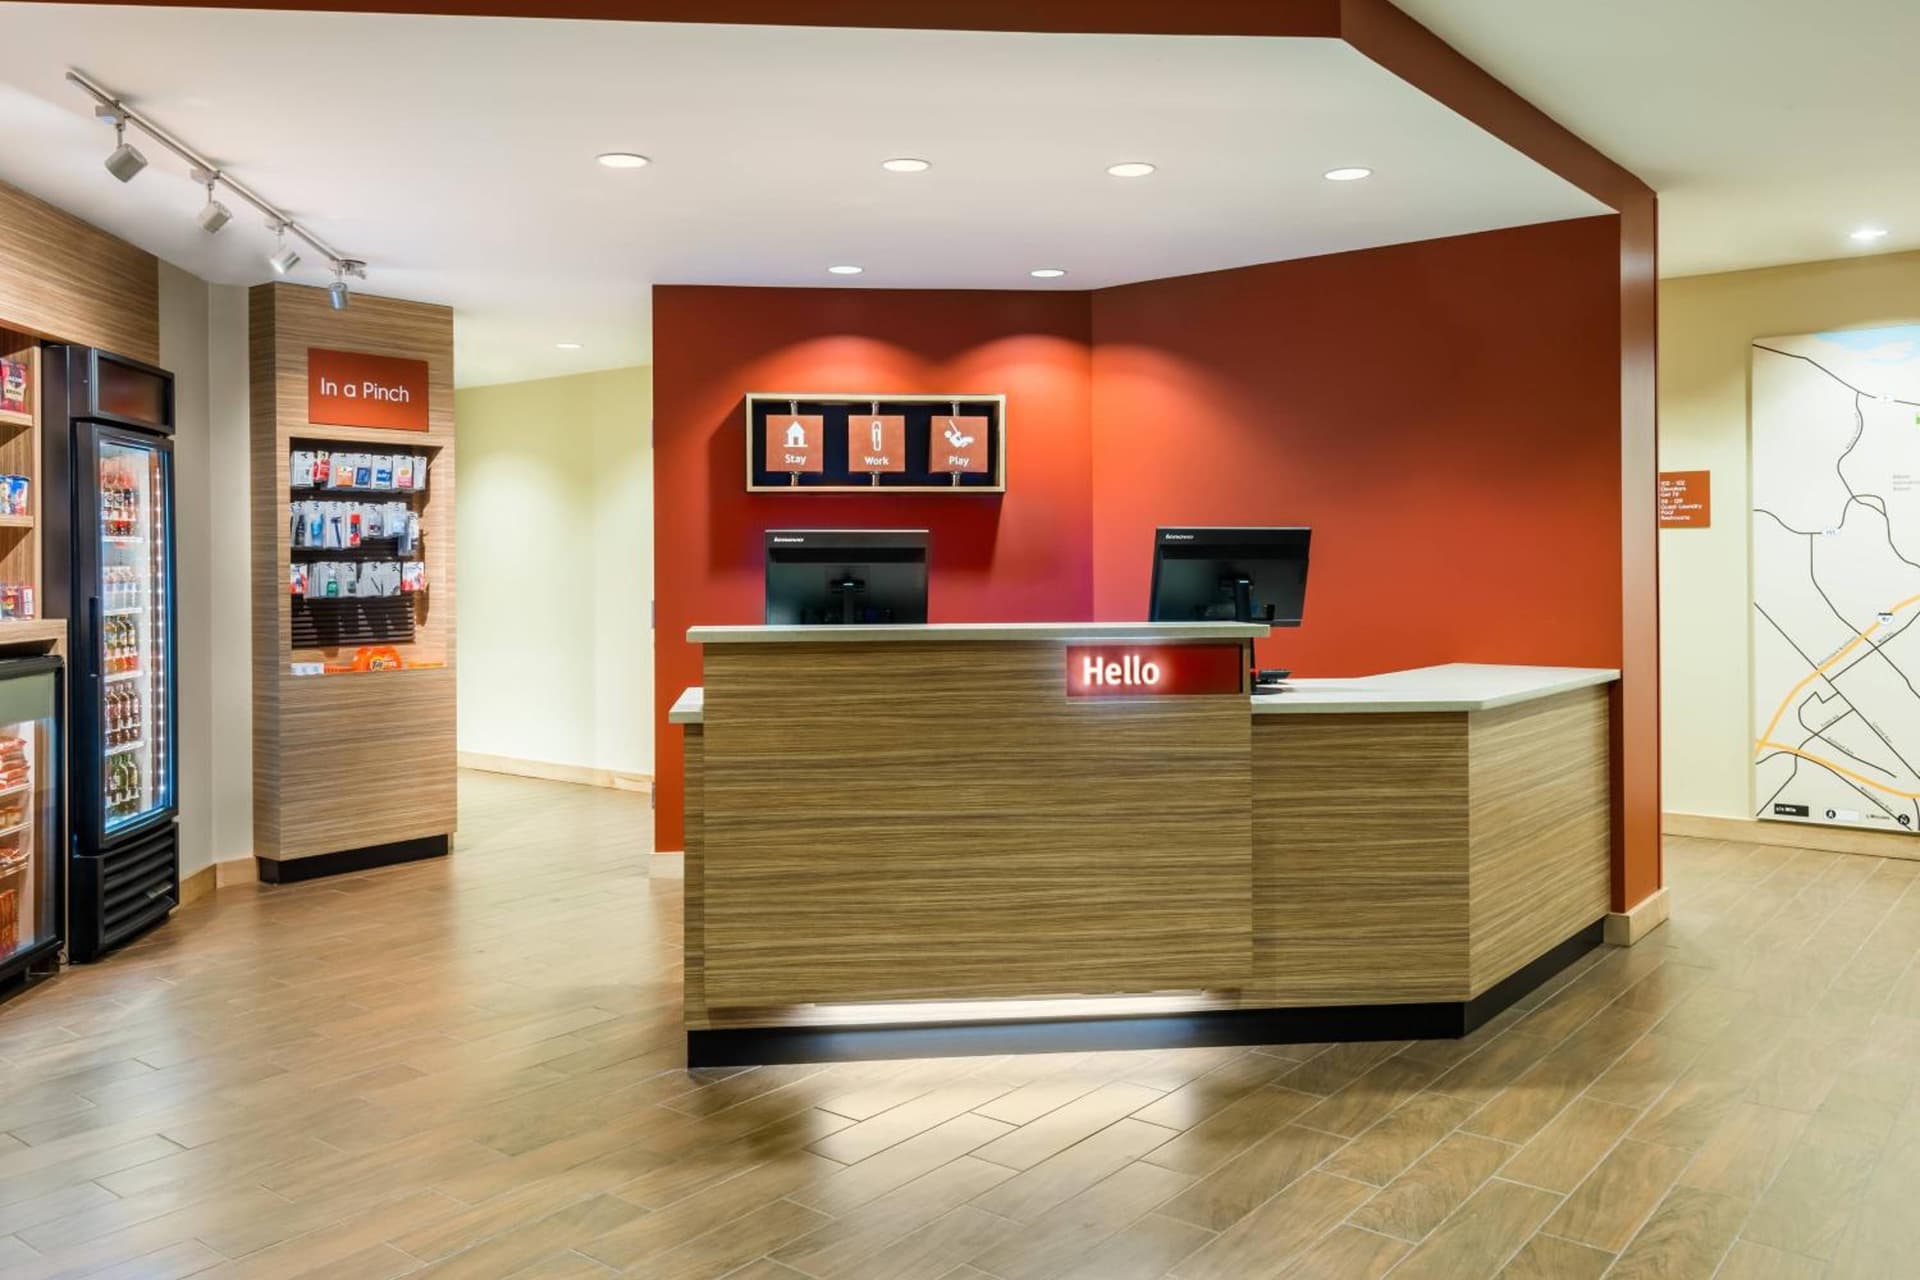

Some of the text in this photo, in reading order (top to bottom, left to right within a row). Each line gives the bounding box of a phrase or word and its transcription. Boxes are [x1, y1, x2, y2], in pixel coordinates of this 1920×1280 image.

[320, 377, 410, 403] In a Pinch
[784, 454, 807, 466] Stay
[864, 455, 890, 466] Work
[949, 455, 970, 467] Play
[1082, 655, 1161, 686] Hello
